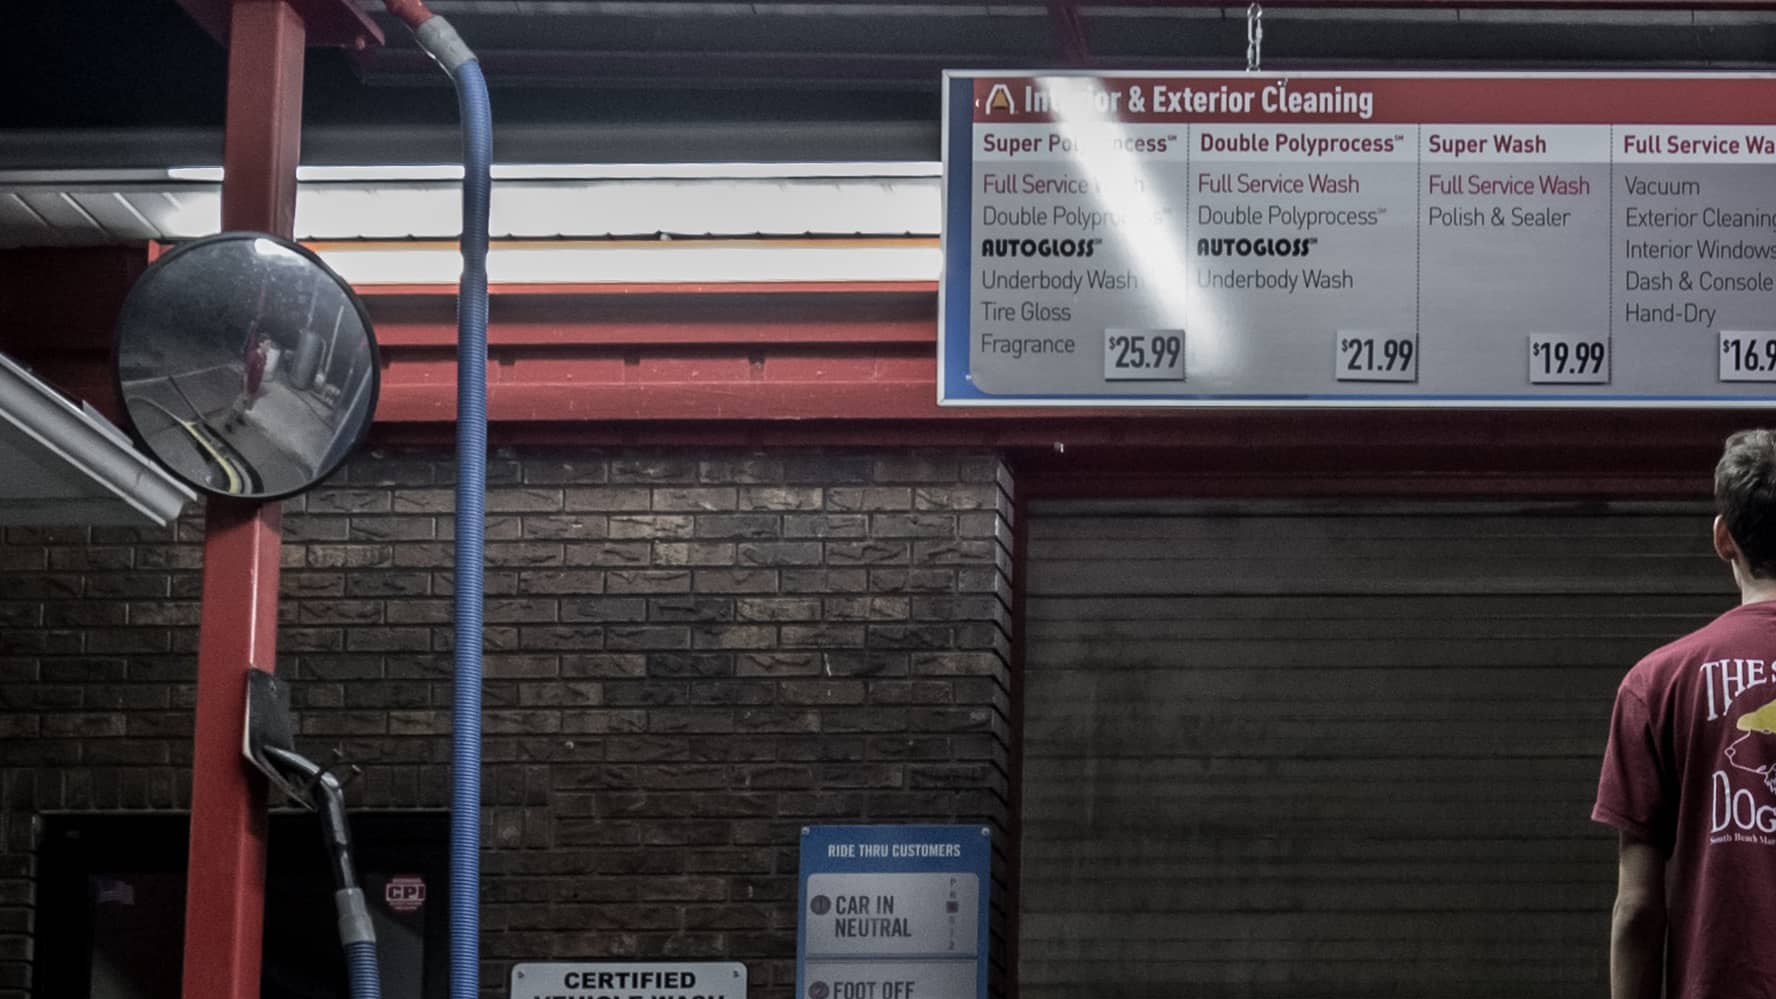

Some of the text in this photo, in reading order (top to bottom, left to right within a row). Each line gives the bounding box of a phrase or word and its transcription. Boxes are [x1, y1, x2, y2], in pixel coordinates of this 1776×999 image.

[1128, 86, 1147, 113] &
[1153, 86, 1254, 114] Exterior
[1261, 86, 1374, 119] Cleaning
[983, 134, 1043, 157] Super
[1200, 134, 1270, 153] Double
[1428, 134, 1547, 157] Super Wash
[1623, 135, 1661, 155] Full
[1666, 135, 1740, 155] Service
[983, 174, 1017, 195] Full
[1022, 174, 1088, 195] Service
[1198, 174, 1360, 195] Full Service Wash
[1428, 175, 1591, 196] Full Service Wash
[1624, 176, 1700, 196] Vacuum
[983, 206, 1048, 226] Double
[1198, 206, 1263, 226] Double
[1428, 207, 1572, 228] Polish & Sealer
[1625, 208, 1699, 228] Exterior
[1625, 240, 1692, 260] Interior
[981, 269, 1138, 294] Underbody Wash
[1197, 268, 1354, 293] Underbody Wash
[1625, 271, 1774, 292] Dash & Console
[981, 302, 1071, 322] Tire Gloss
[1625, 303, 1717, 328] Hand-Dry
[981, 334, 1076, 358] Fragrance
[1108, 335, 1181, 369] $25.99
[1342, 338, 1413, 372] $21.99
[1532, 342, 1605, 374] $19.99
[1700, 658, 1767, 721] THE
[828, 844, 961, 858] RIDE THRU CUSTOMERS
[388, 886, 424, 899] CPI
[835, 896, 871, 915] CAR
[876, 895, 894, 914] IN
[835, 918, 912, 938] NEUTRAL
[564, 972, 696, 989] CERTIFIED
